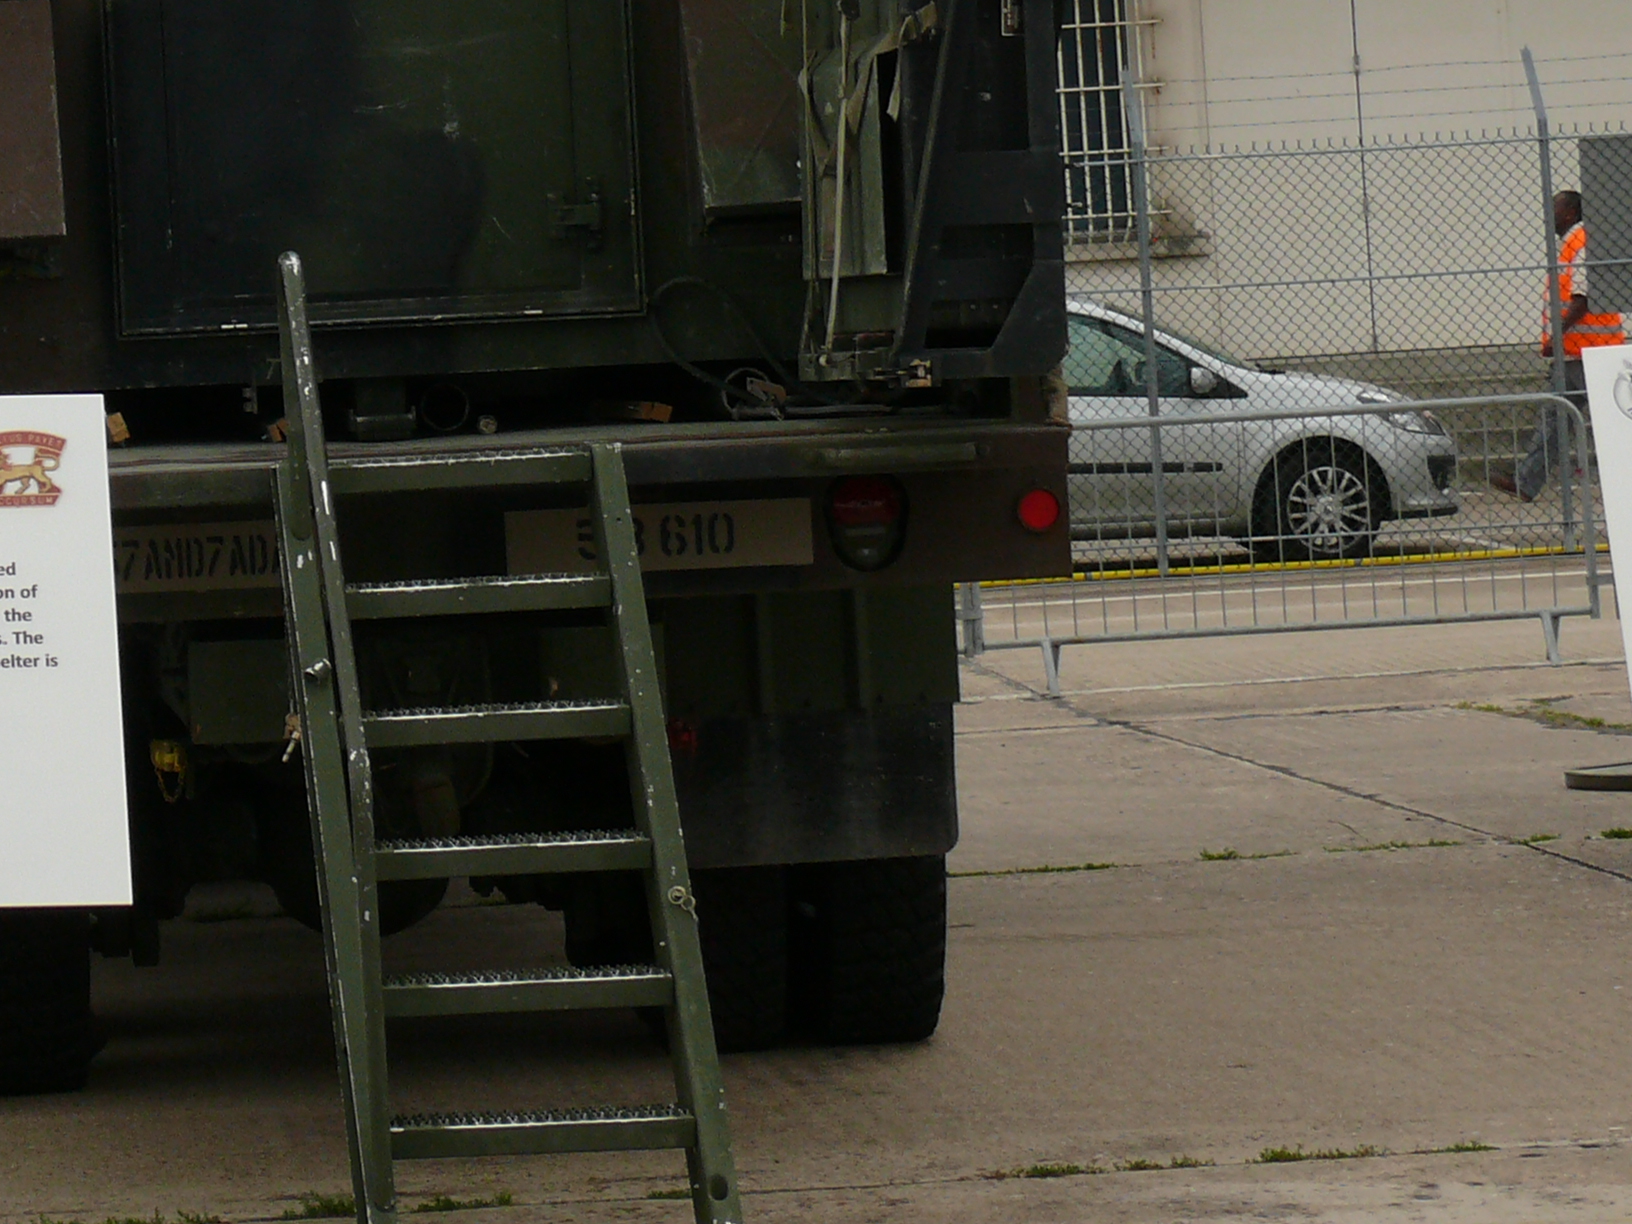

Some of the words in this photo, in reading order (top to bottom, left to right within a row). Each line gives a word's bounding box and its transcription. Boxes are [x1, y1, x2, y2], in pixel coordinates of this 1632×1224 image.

[659, 511, 735, 557] 610
[20, 584, 38, 599] of
[4, 608, 32, 622] the
[12, 630, 44, 645] The
[45, 654, 58, 667] is
